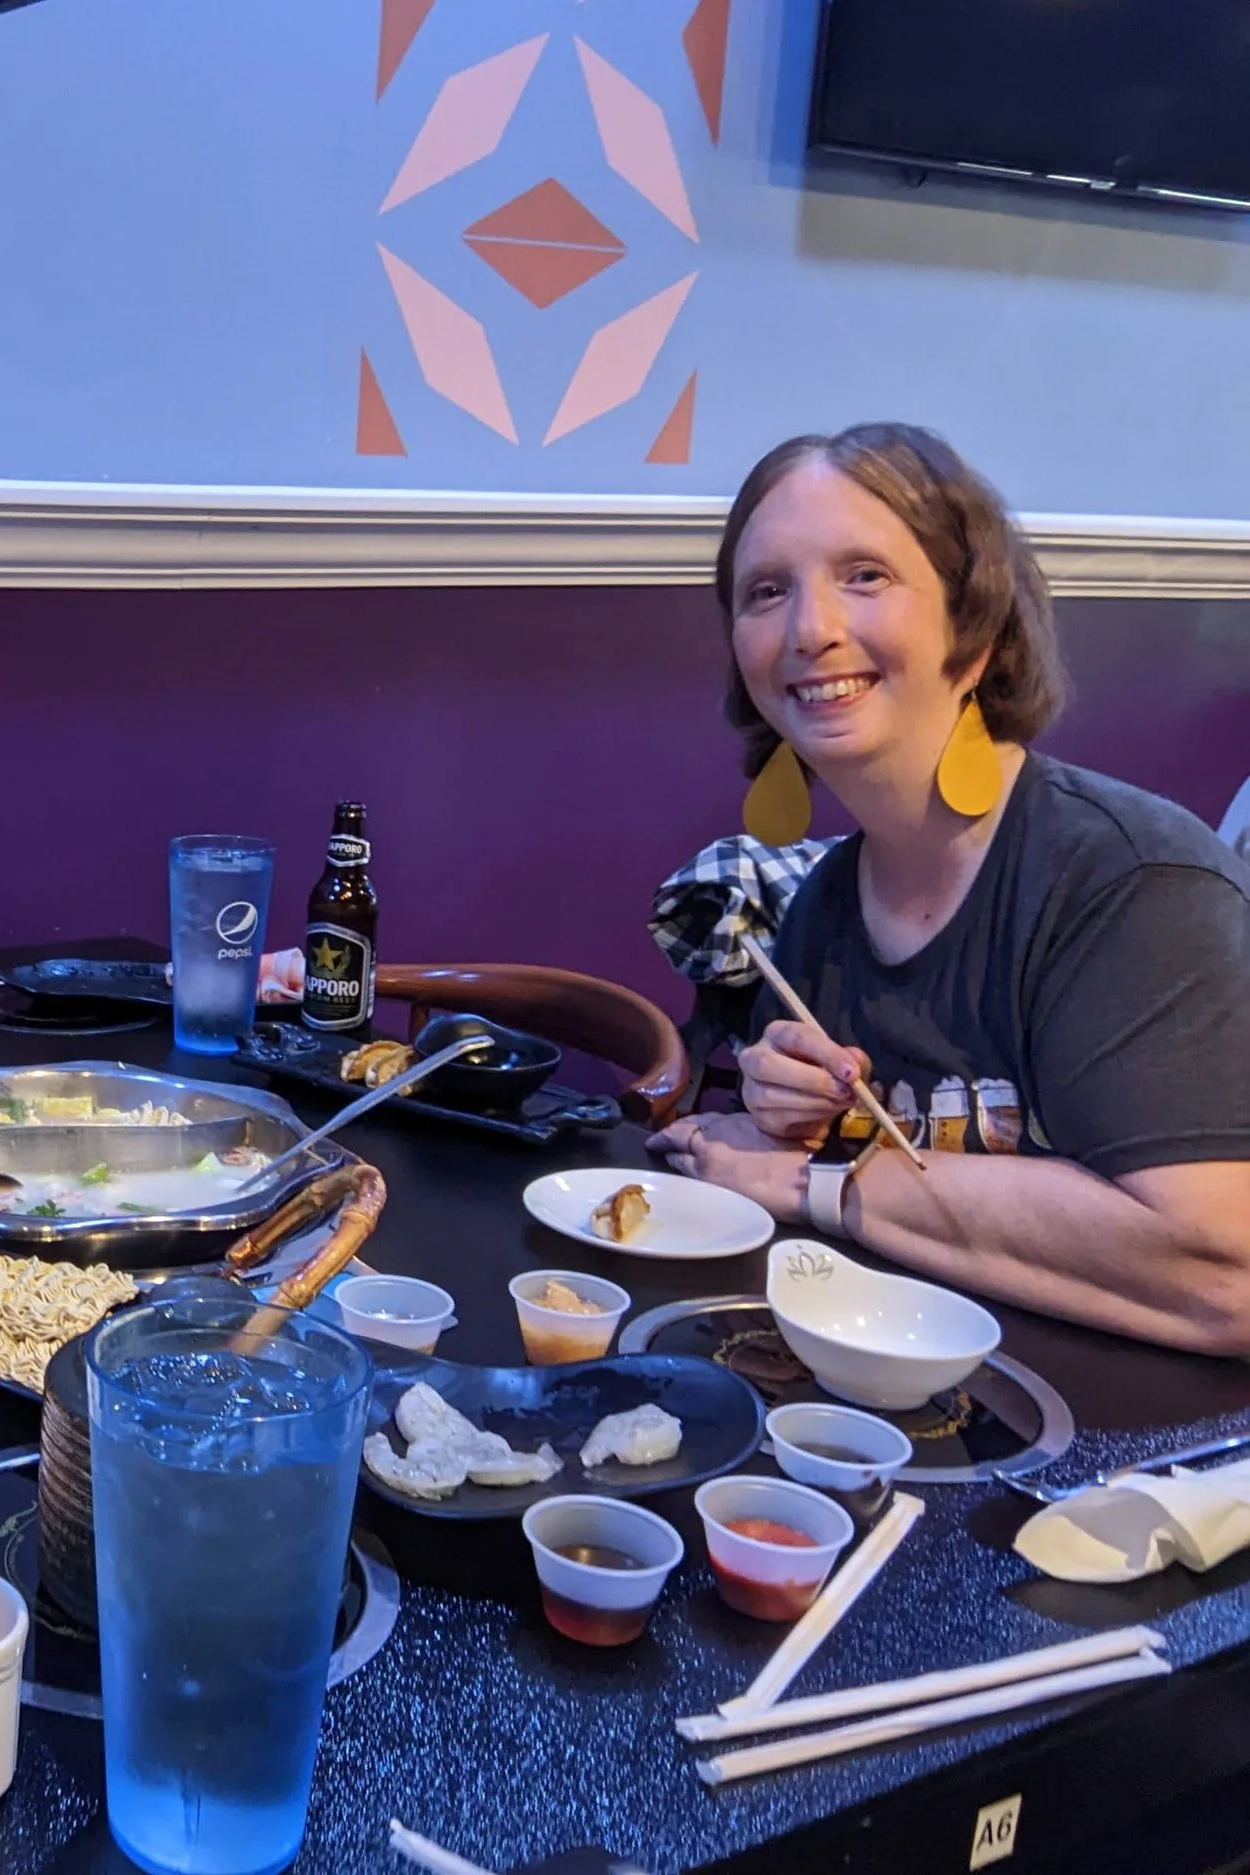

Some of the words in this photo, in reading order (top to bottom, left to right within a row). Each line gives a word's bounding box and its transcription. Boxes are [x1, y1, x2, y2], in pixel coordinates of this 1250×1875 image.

[328, 842, 362, 854] APPORO
[217, 946, 252, 960] pepsi
[305, 975, 359, 997] APPORO
[976, 1810, 1013, 1850] A6
